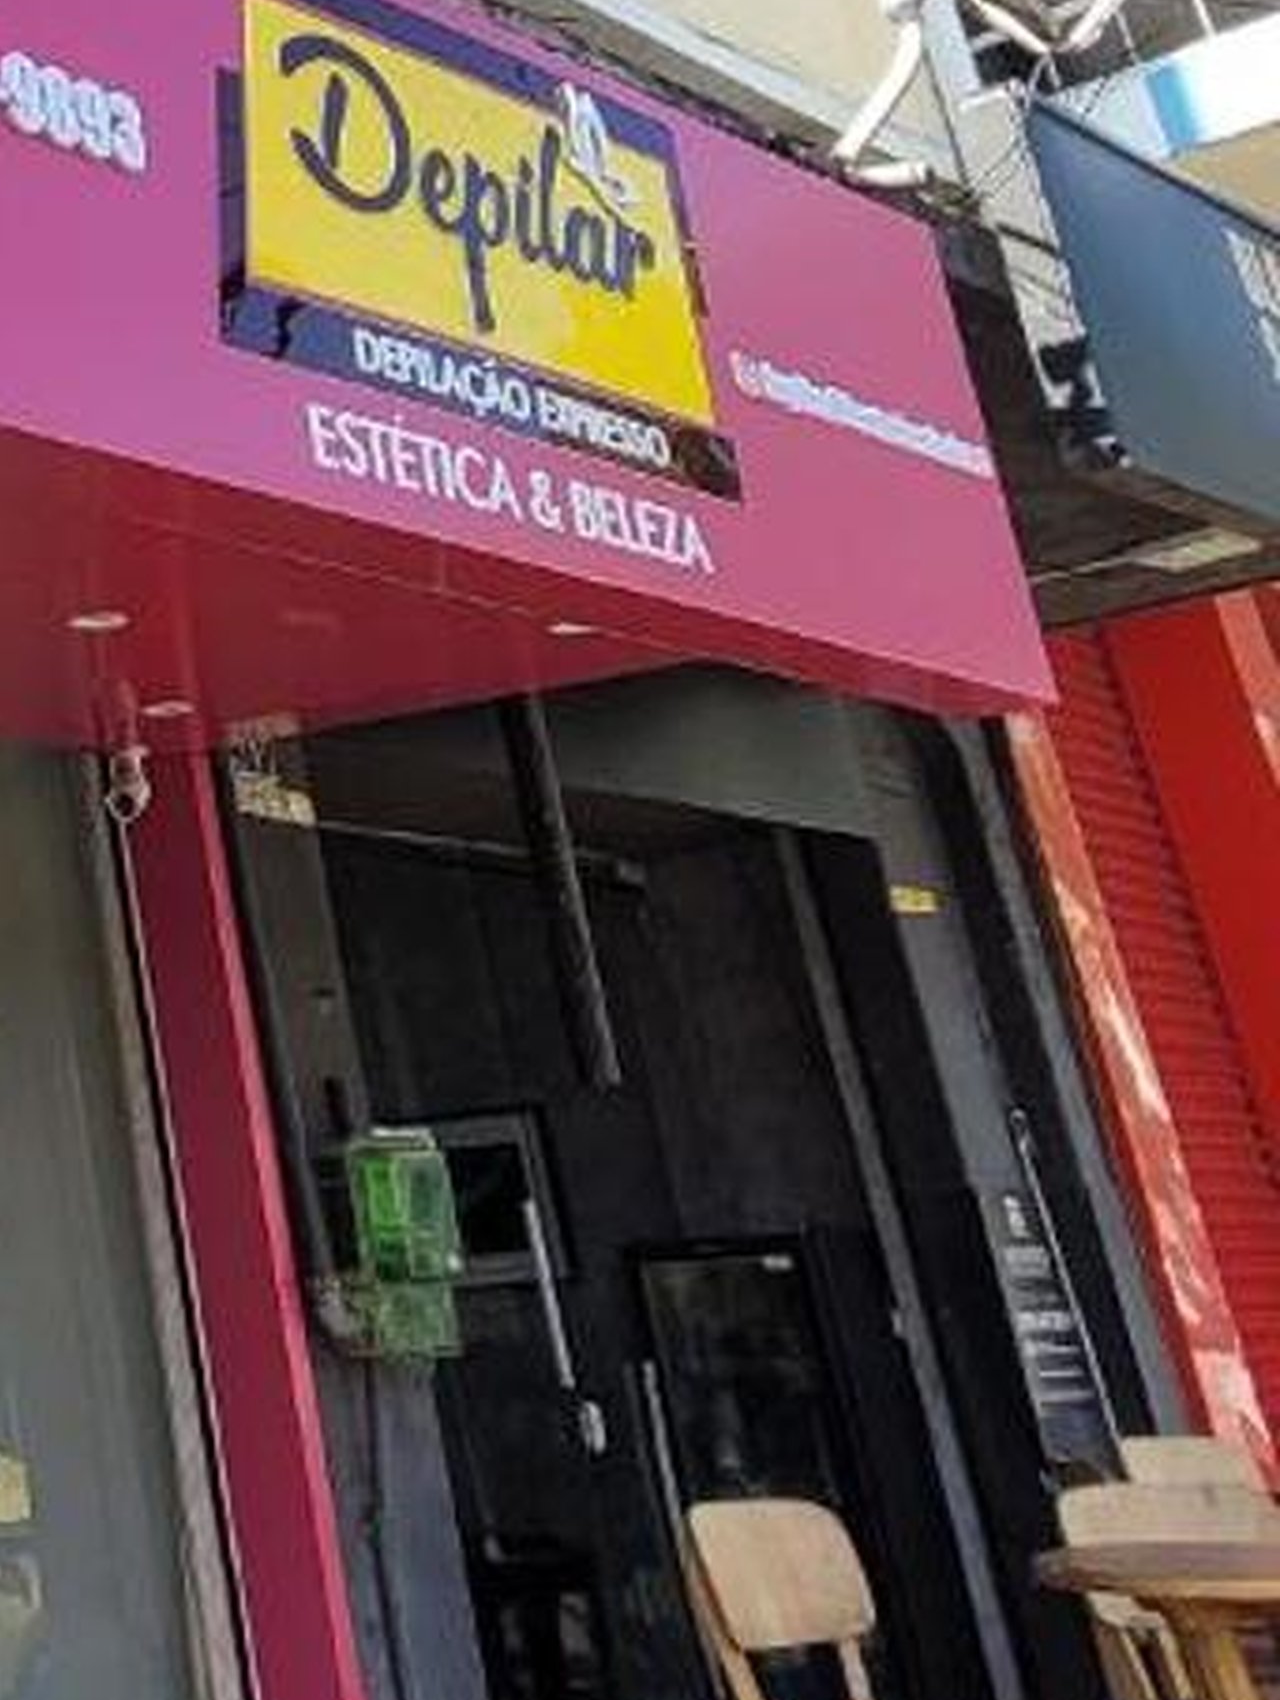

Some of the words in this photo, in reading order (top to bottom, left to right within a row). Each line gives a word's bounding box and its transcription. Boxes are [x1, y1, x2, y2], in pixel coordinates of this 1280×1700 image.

[279, 33, 656, 334] Depilar
[352, 326, 532, 419] DEPILAÇÃO
[307, 405, 523, 523] ESTÉTICA
[528, 469, 565, 534] &
[568, 480, 716, 574] BELEZA
